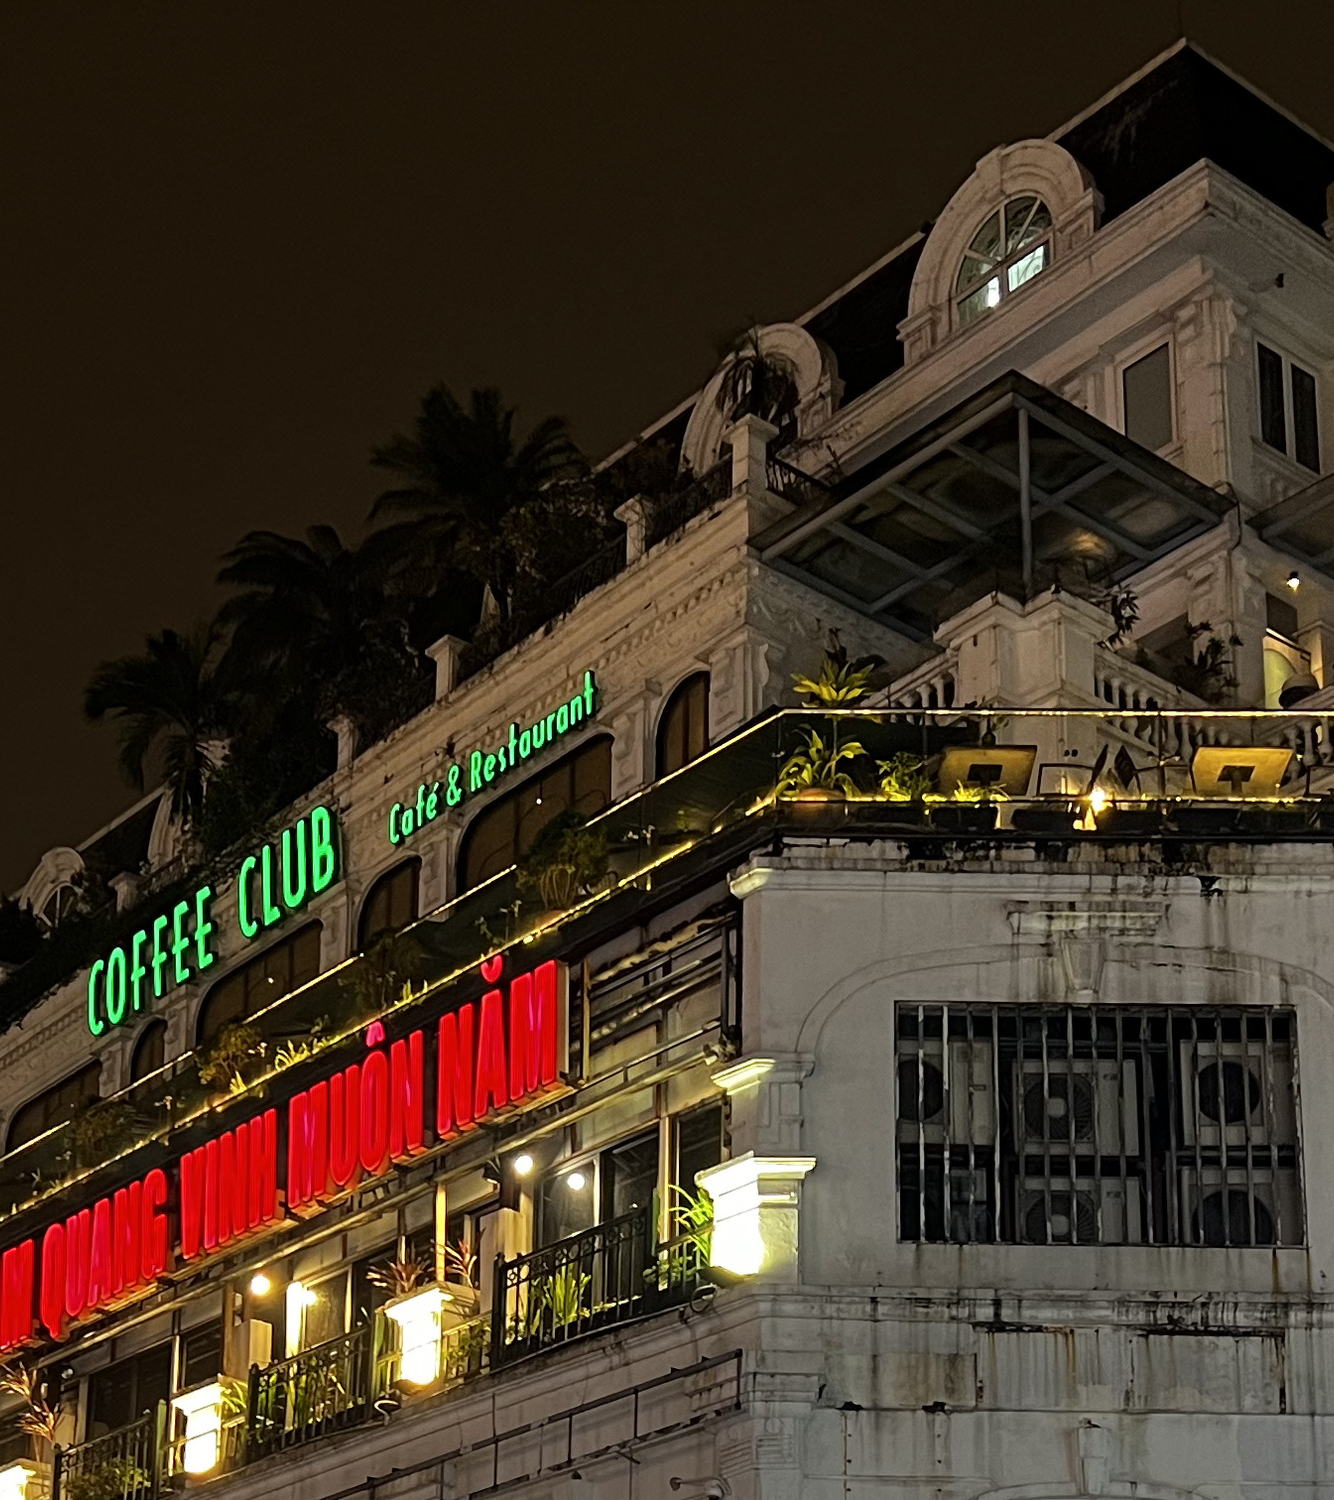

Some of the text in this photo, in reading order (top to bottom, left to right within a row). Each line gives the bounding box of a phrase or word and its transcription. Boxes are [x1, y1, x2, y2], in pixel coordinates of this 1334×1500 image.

[389, 670, 598, 846] Café & Restaurant
[87, 805, 338, 1036] COFFEE CLUB
[41, 1169, 167, 1340] QUANG
[180, 1108, 277, 1260] VINH
[288, 1021, 424, 1209] MUÔN
[437, 955, 558, 1141] NĂM
